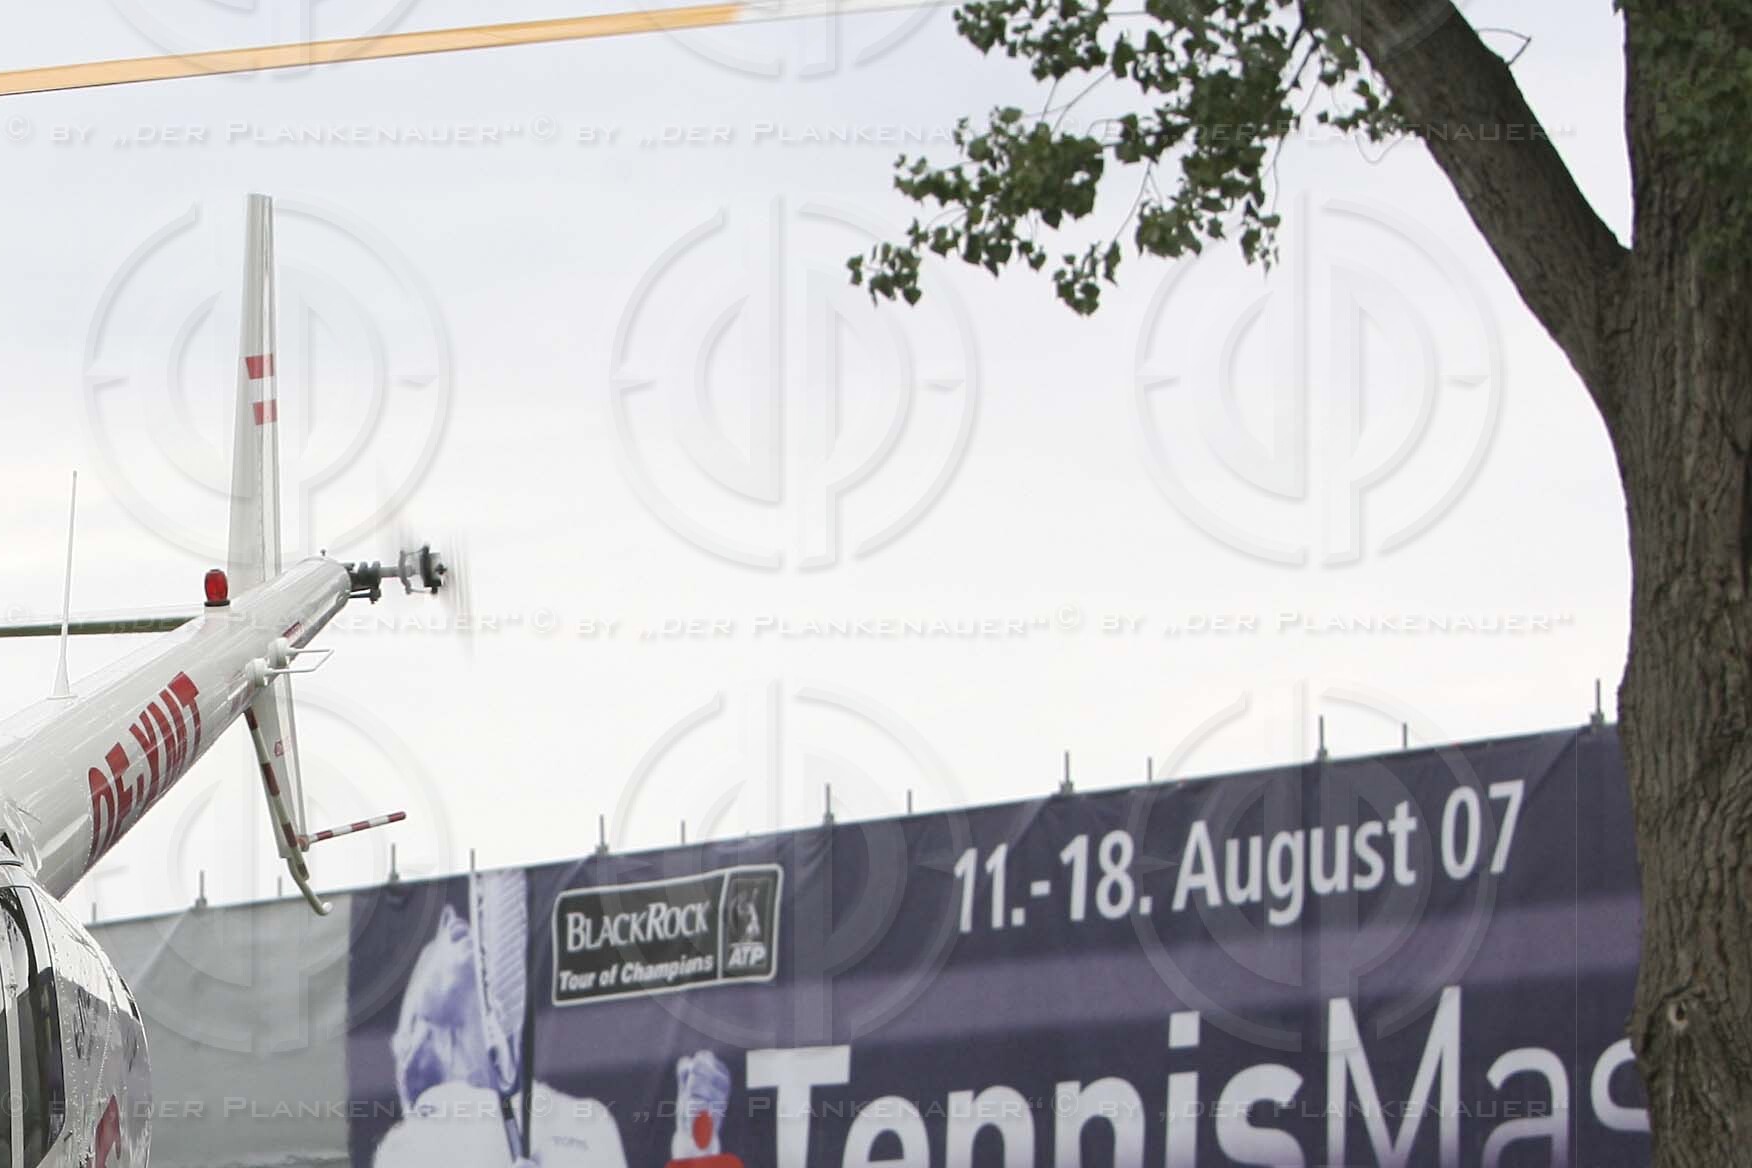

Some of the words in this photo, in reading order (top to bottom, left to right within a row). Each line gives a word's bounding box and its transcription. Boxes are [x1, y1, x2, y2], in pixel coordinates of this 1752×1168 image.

[1172, 800, 1417, 927] August
[1441, 779, 1525, 881] 07
[559, 970, 595, 992] Tour
[599, 965, 617, 986] of
[620, 954, 714, 983] Champions
[728, 942, 767, 968] ATP
